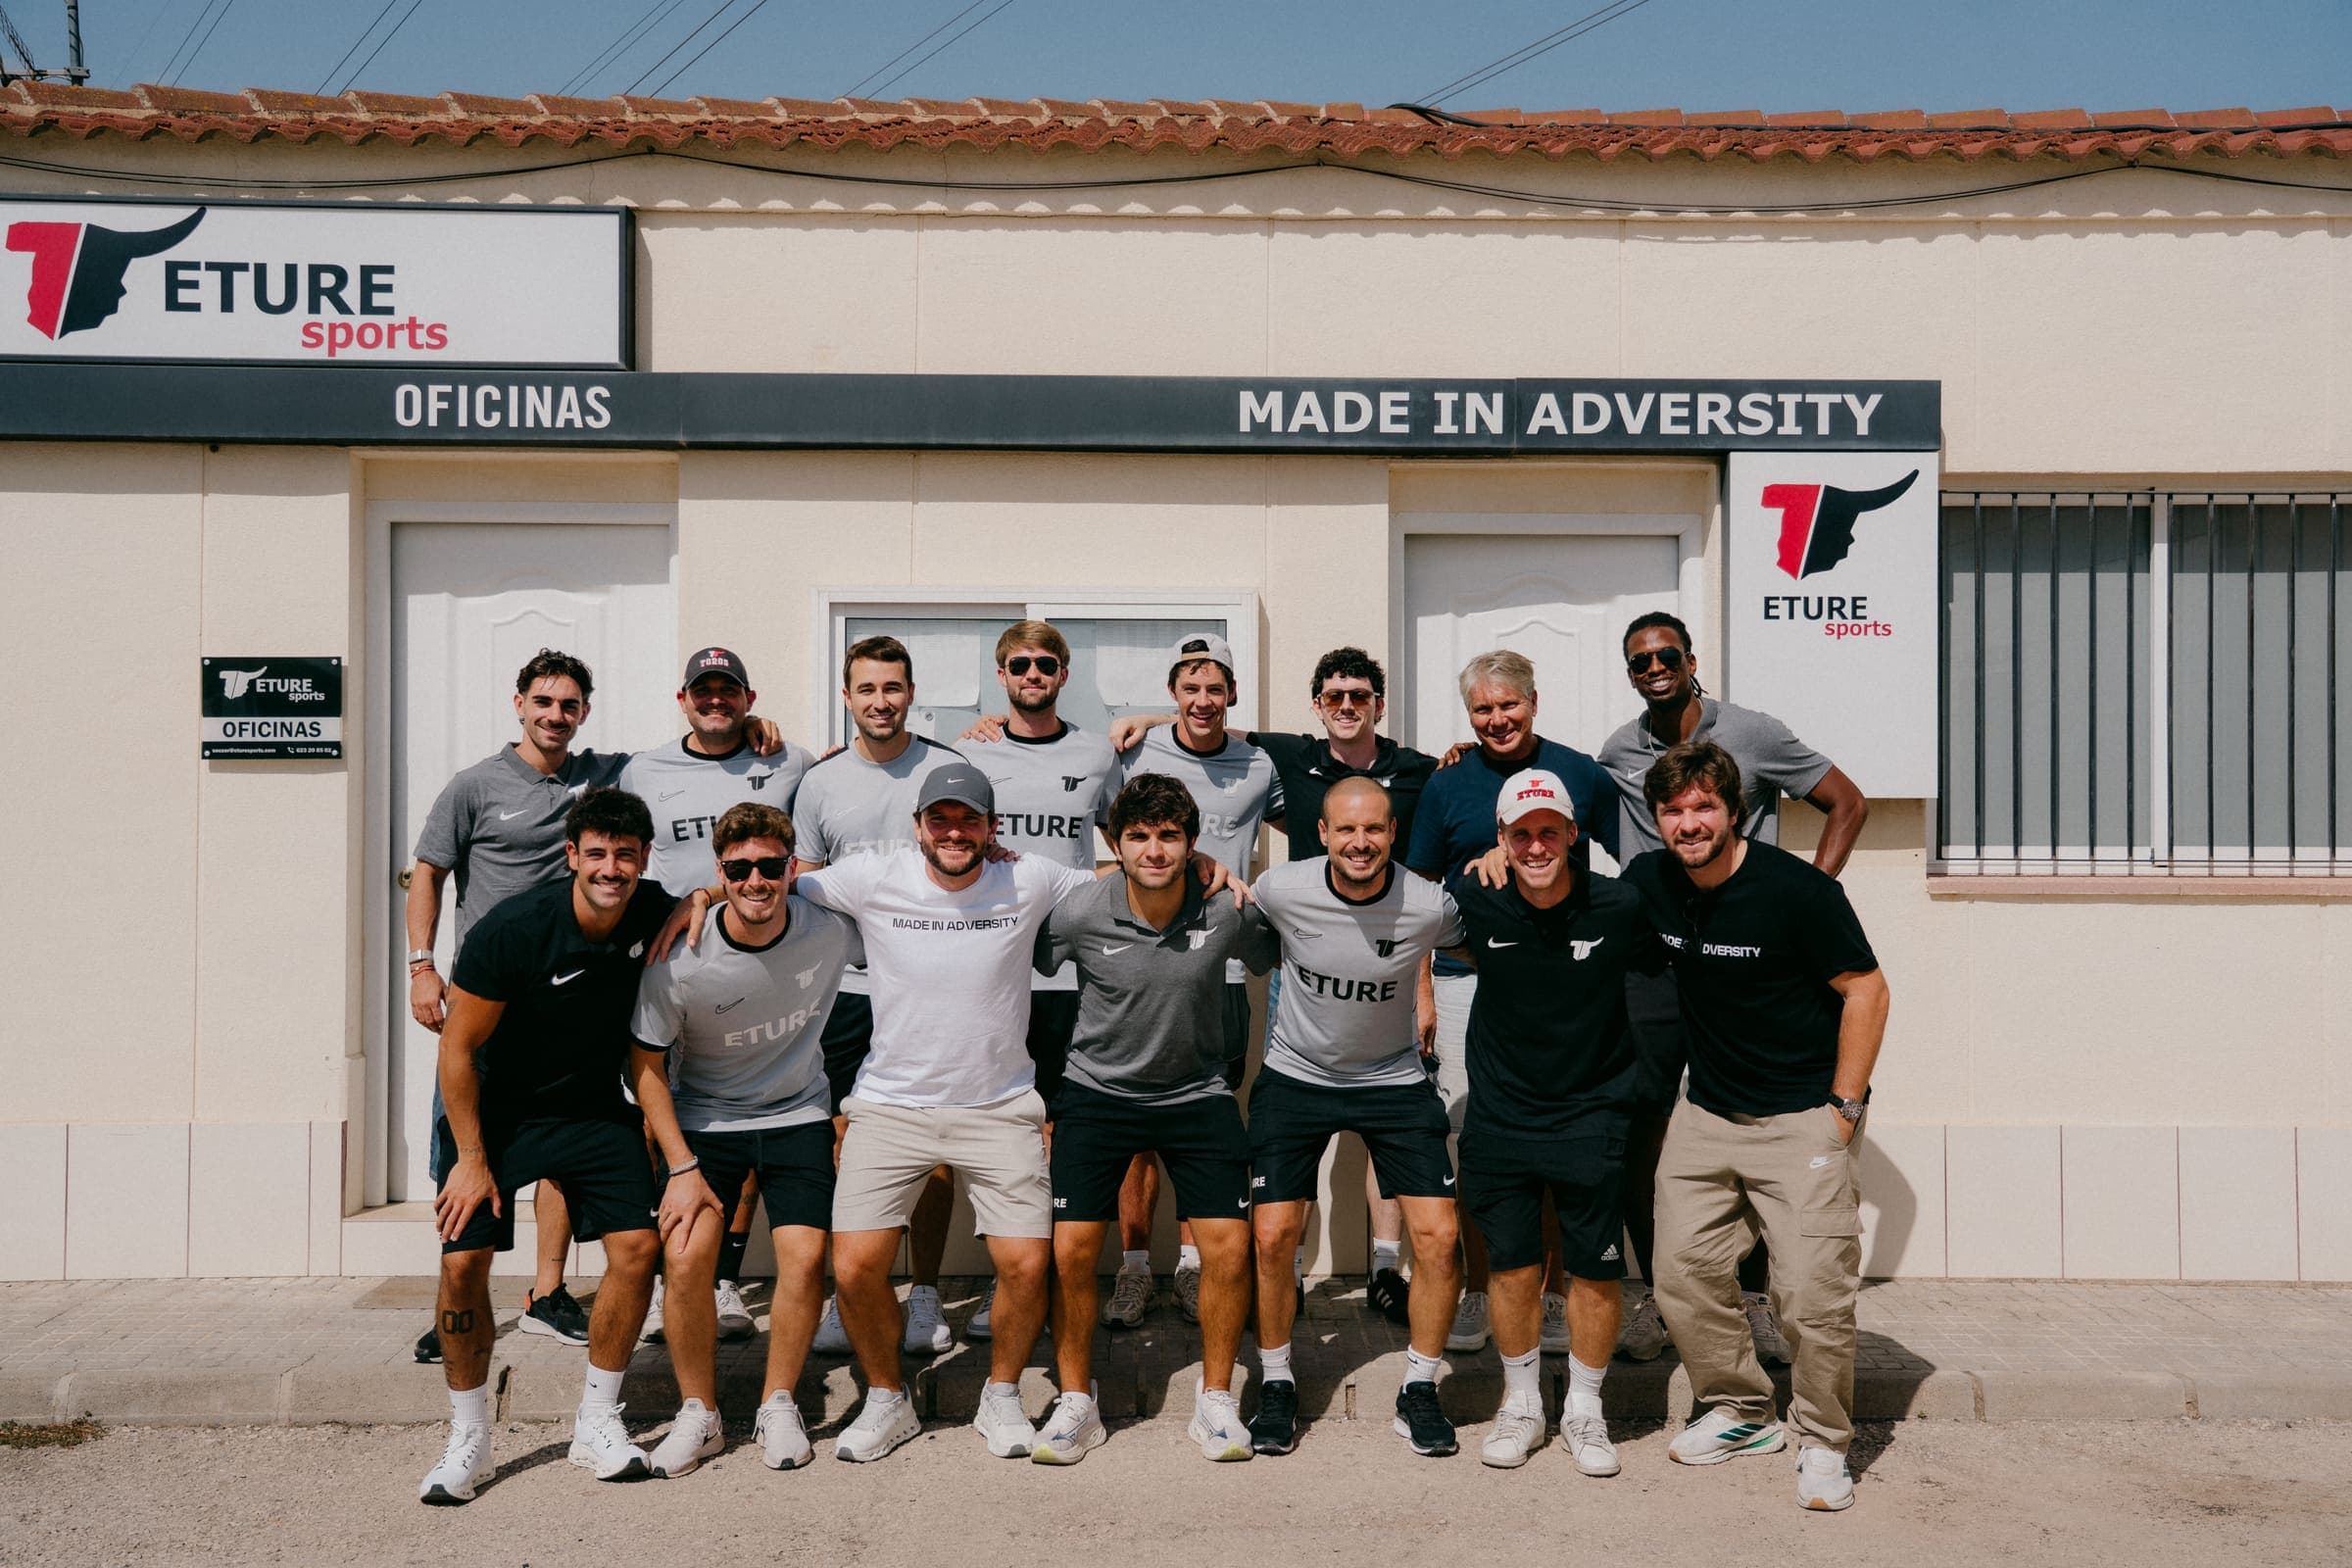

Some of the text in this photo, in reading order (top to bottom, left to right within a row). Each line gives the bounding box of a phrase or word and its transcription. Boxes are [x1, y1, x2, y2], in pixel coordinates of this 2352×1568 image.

[165, 261, 396, 316] ETURE
[301, 316, 449, 358] sports
[394, 383, 612, 429] OFICINAS
[1239, 390, 1884, 436] MADE IN ADVERSITY
[1763, 596, 1869, 621] ETURE
[1824, 619, 1892, 641] sports
[256, 678, 313, 693] ETURE
[288, 690, 325, 703] sports
[222, 721, 321, 738] OFICINAS
[995, 813, 1083, 839] ETURE
[893, 916, 1018, 931] MADE IN ADVERSITY
[1298, 964, 1398, 1003] ETURE
[724, 997, 822, 1048] ETURE
